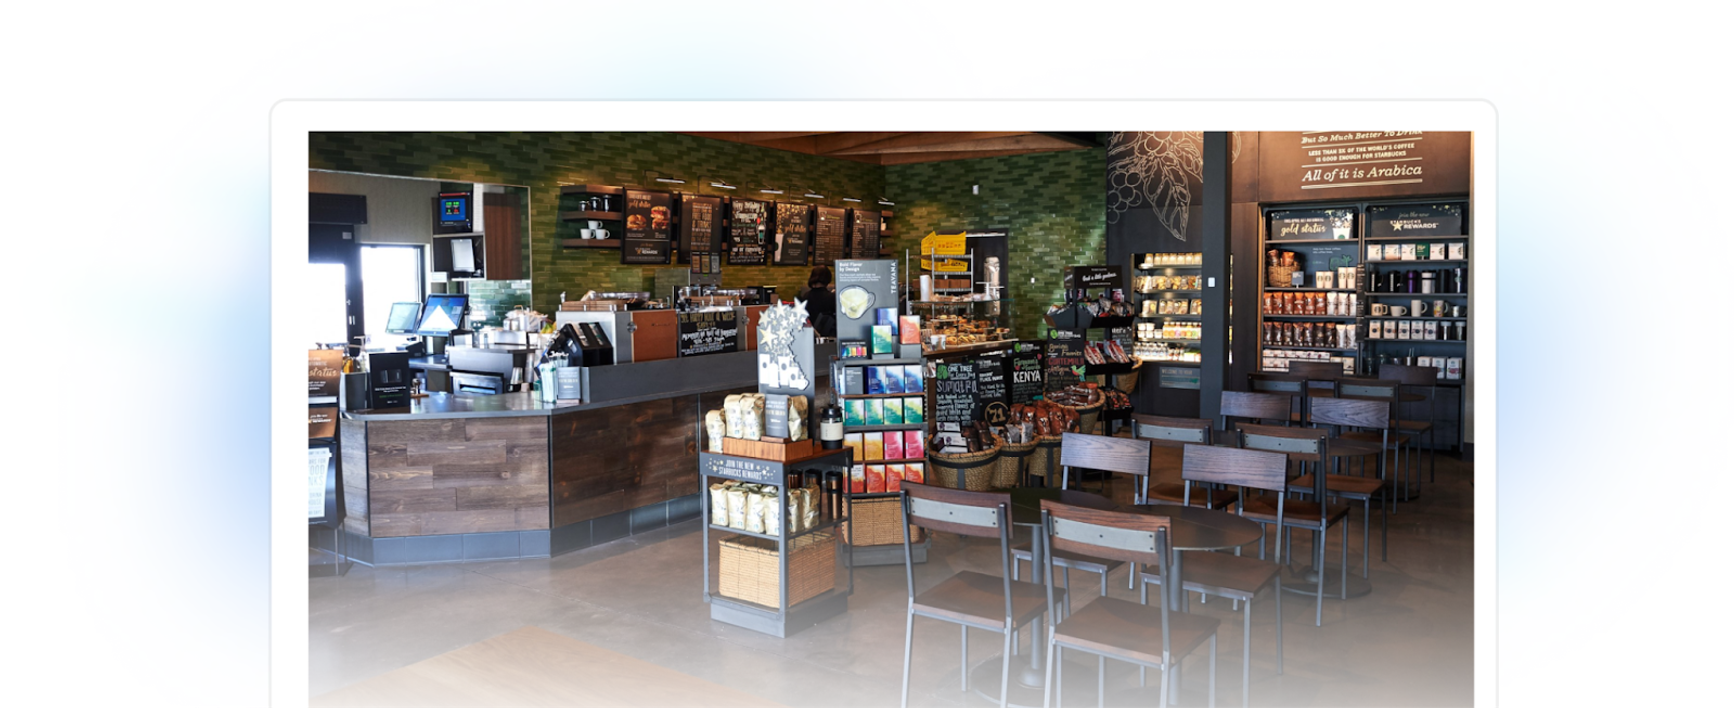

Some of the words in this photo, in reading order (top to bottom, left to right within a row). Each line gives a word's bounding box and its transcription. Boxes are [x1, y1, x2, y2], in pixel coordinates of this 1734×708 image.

[1330, 133, 1354, 142] Much
[1374, 150, 1406, 158] STARBUCKS
[1302, 169, 1322, 182] All
[1323, 168, 1339, 182] of
[1340, 168, 1349, 179] it
[1352, 167, 1364, 178] is
[1366, 164, 1422, 178] Arabica
[1281, 223, 1299, 236] gold
[1300, 223, 1326, 233] status
[309, 366, 337, 377] status
[1013, 370, 1042, 383] KENYA
[726, 460, 736, 468] JOIN
[745, 462, 754, 470] NEW
[719, 466, 742, 478] STARBUCKS
[742, 470, 762, 480] REWARDS
